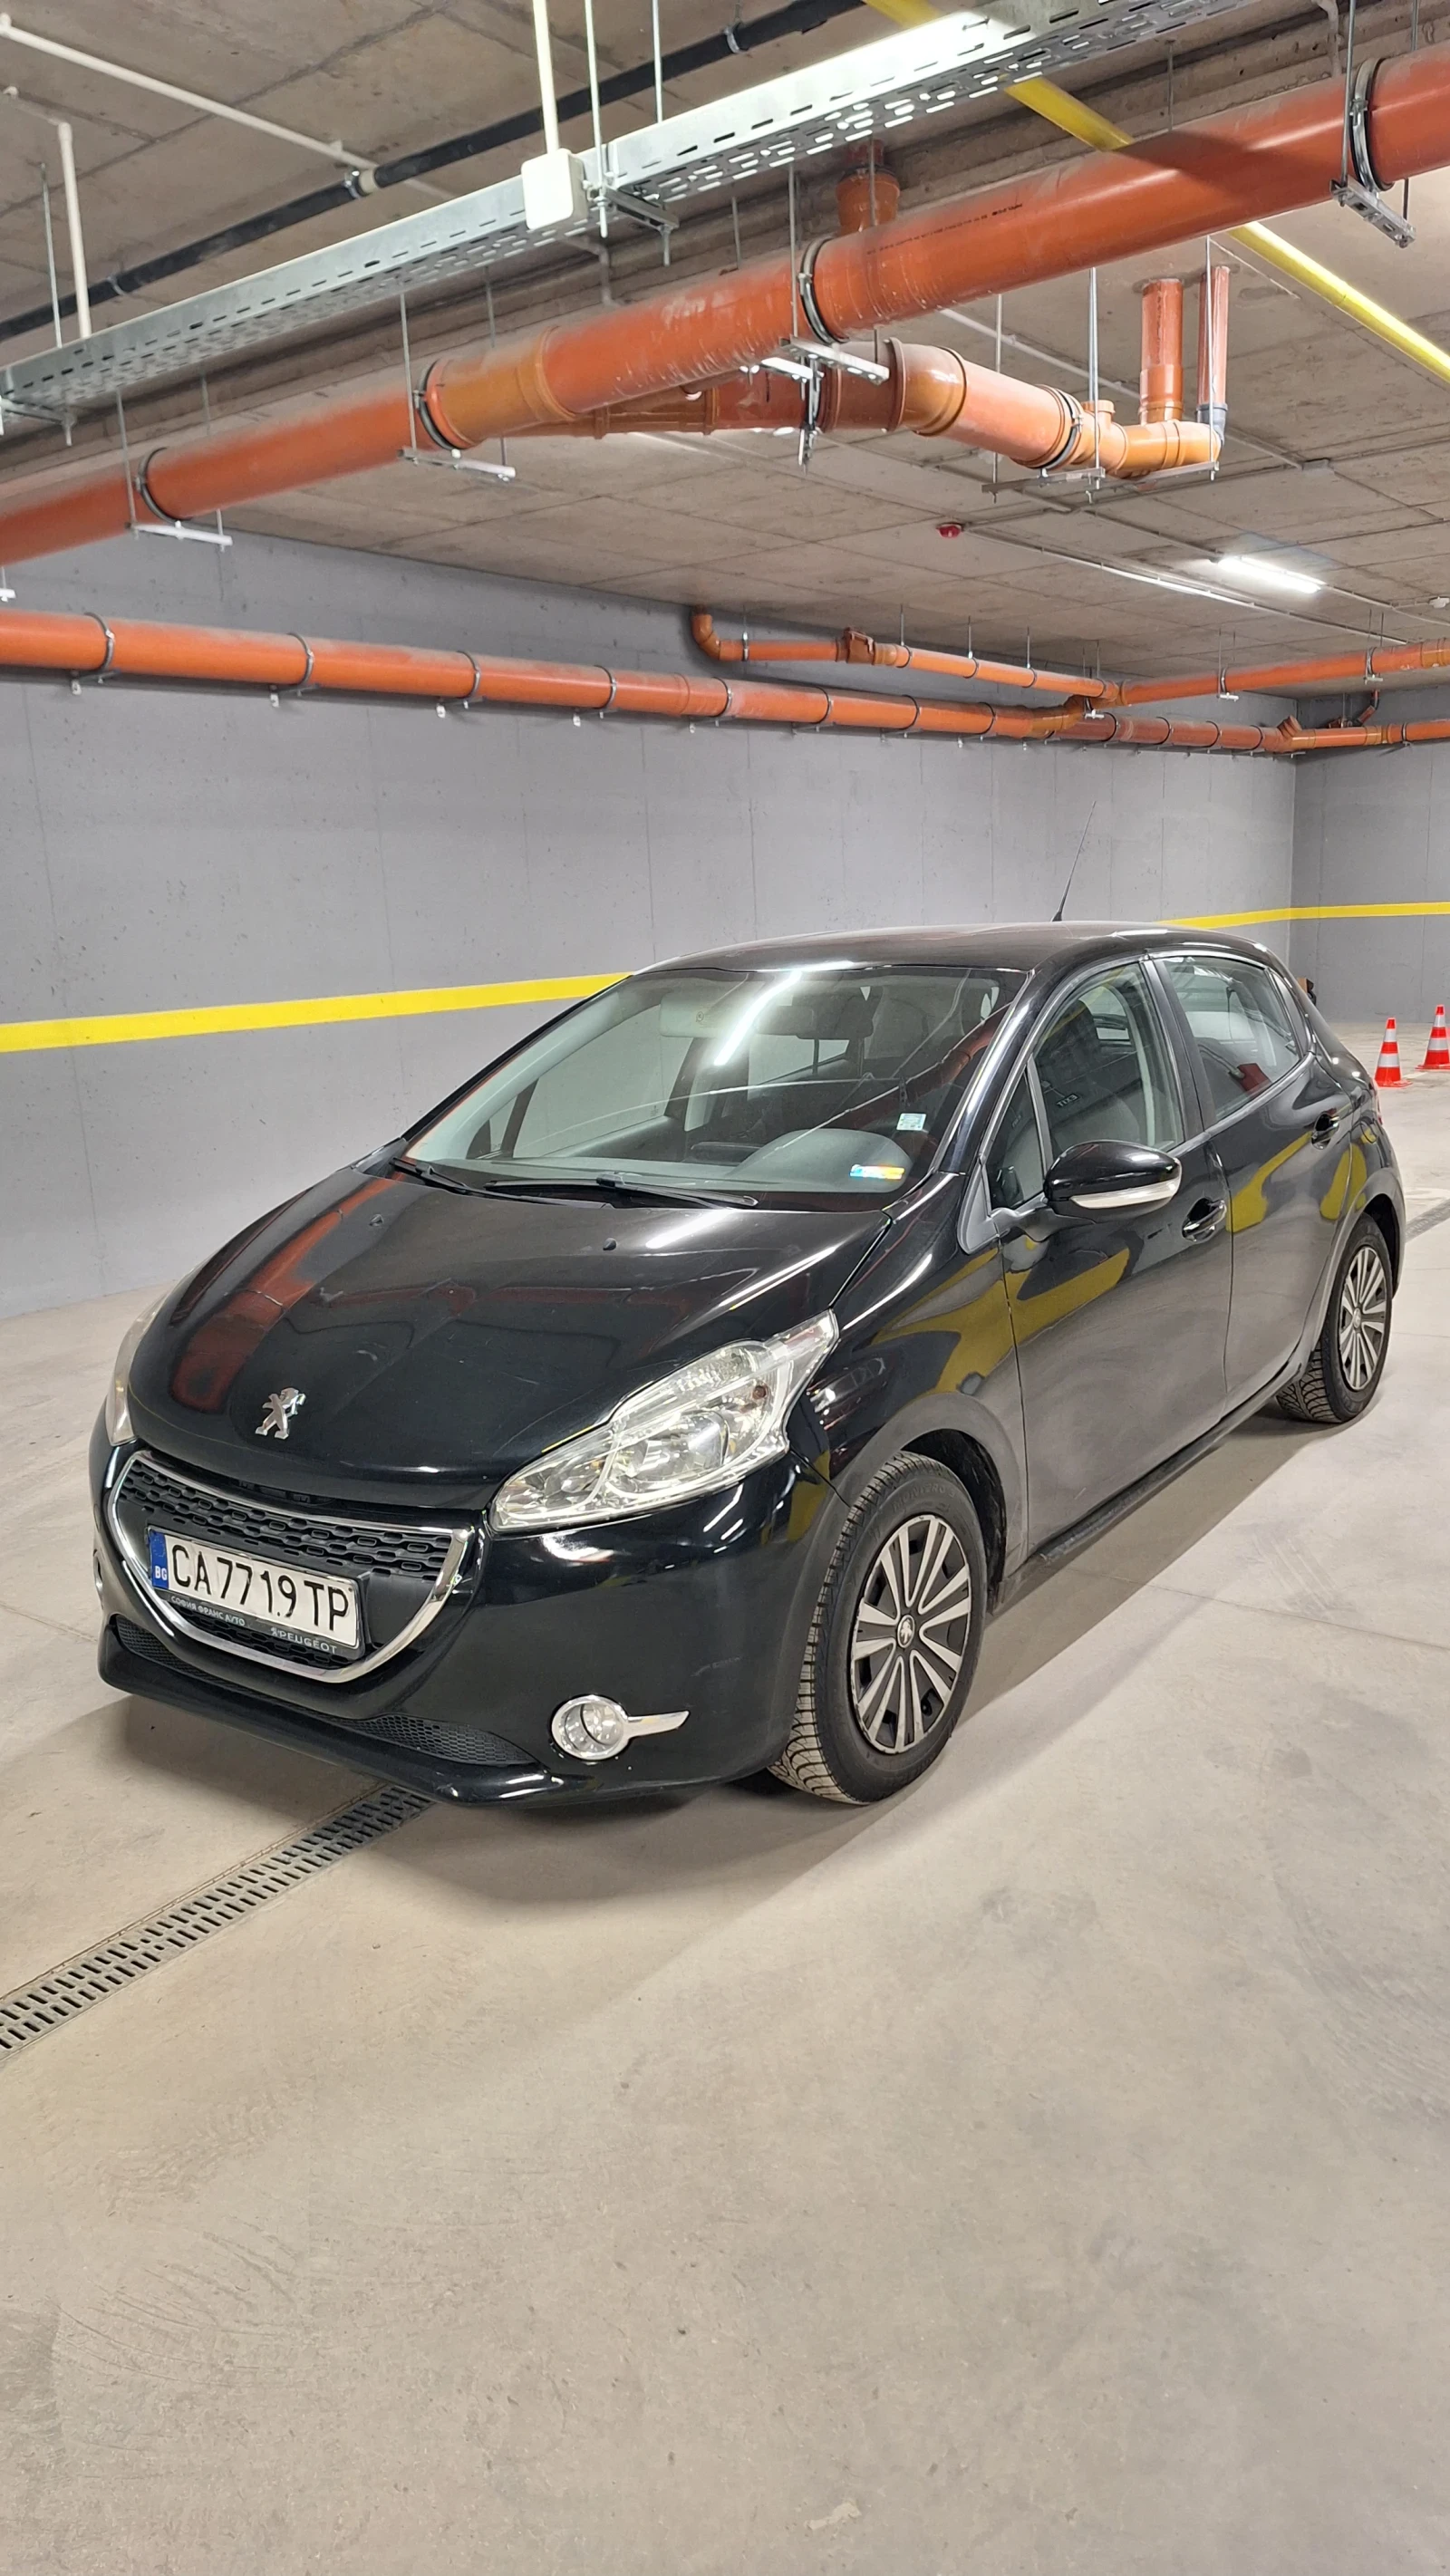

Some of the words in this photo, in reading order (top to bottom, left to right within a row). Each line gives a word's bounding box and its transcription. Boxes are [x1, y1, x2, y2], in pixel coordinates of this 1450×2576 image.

[154, 1565, 168, 1581] BG
[171, 1544, 349, 1631] CA7719TP
[170, 1596, 197, 1611] СОФИЯ
[198, 1605, 224, 1620] ФРАНС
[278, 1630, 337, 1655] PEUGEOT
